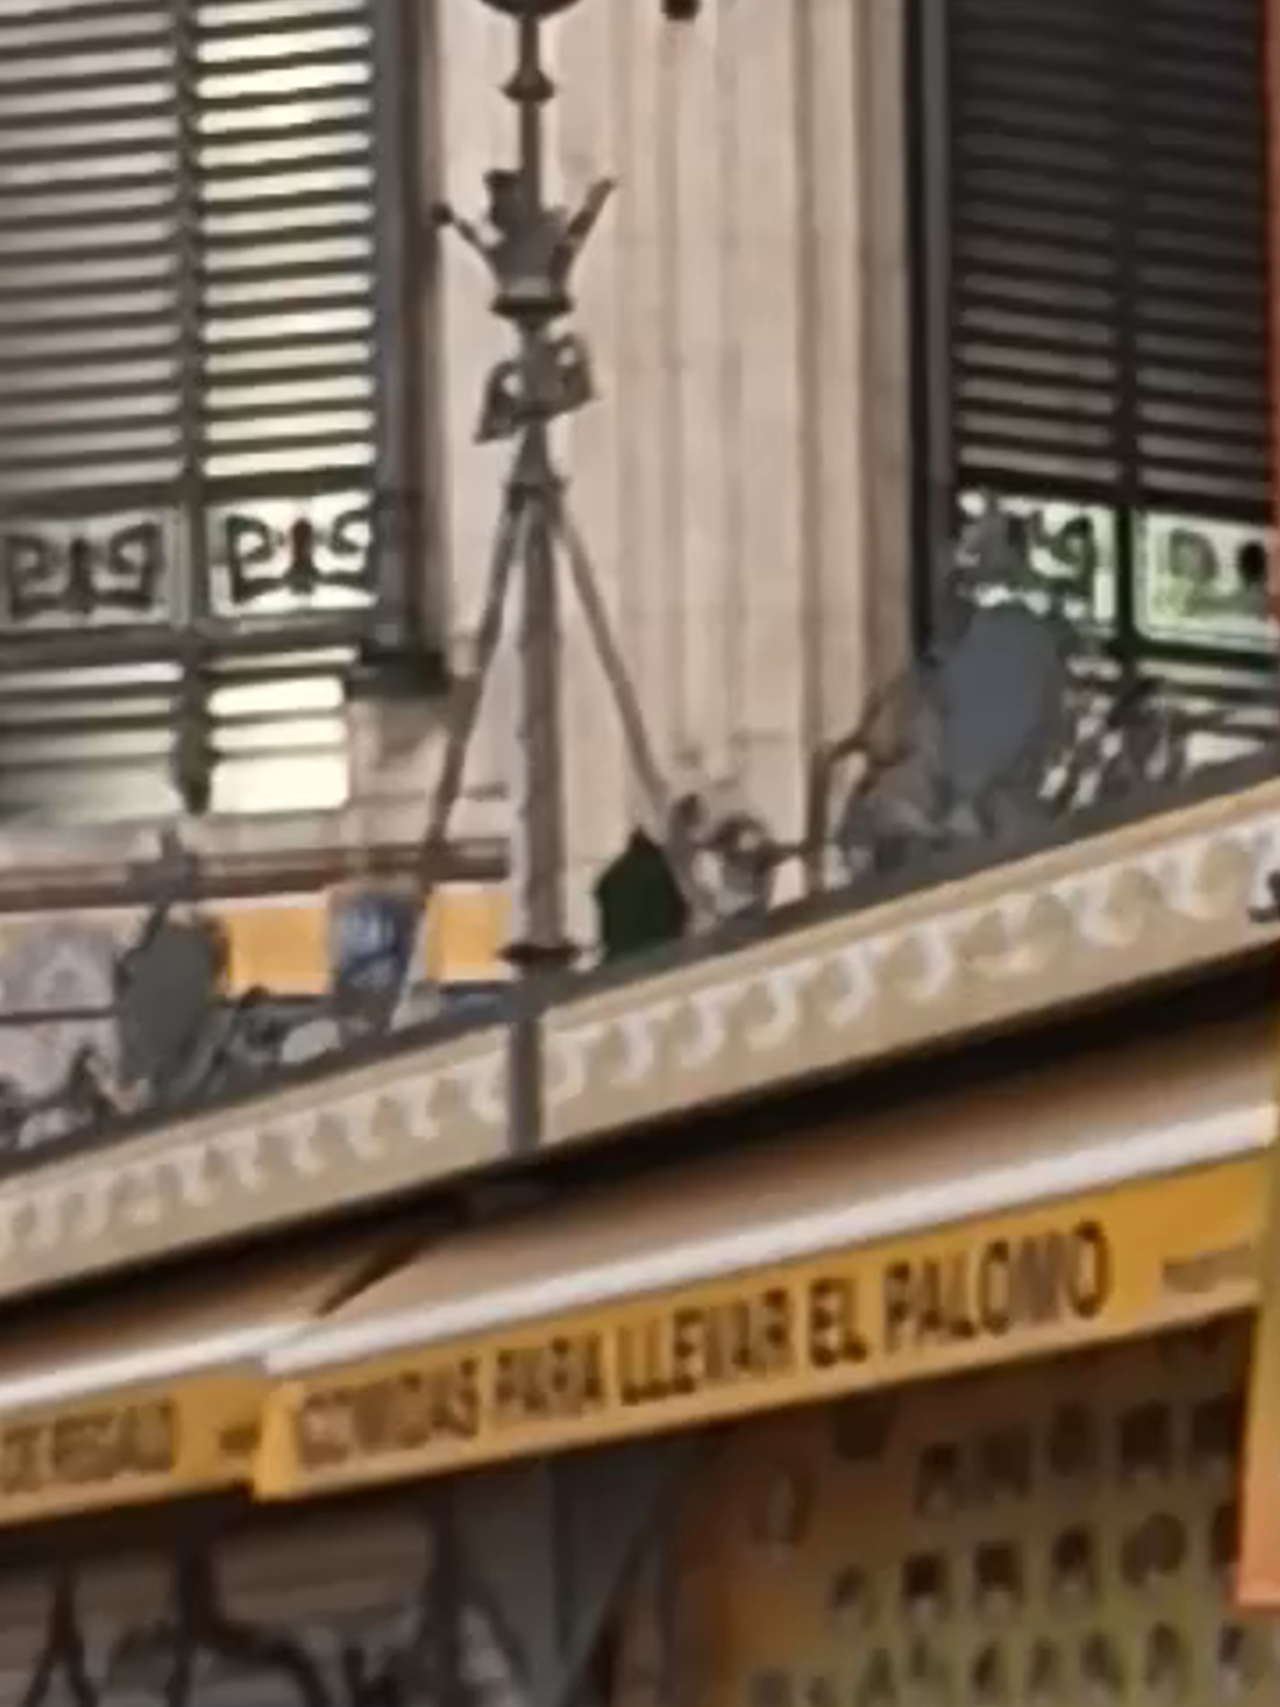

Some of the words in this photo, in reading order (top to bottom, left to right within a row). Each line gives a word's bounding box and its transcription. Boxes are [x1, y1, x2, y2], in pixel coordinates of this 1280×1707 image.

[495, 1333, 605, 1418] PARA
[620, 1290, 792, 1407] LLEVAR
[808, 1275, 869, 1368] EL
[883, 1221, 1110, 1353] PALOMO
